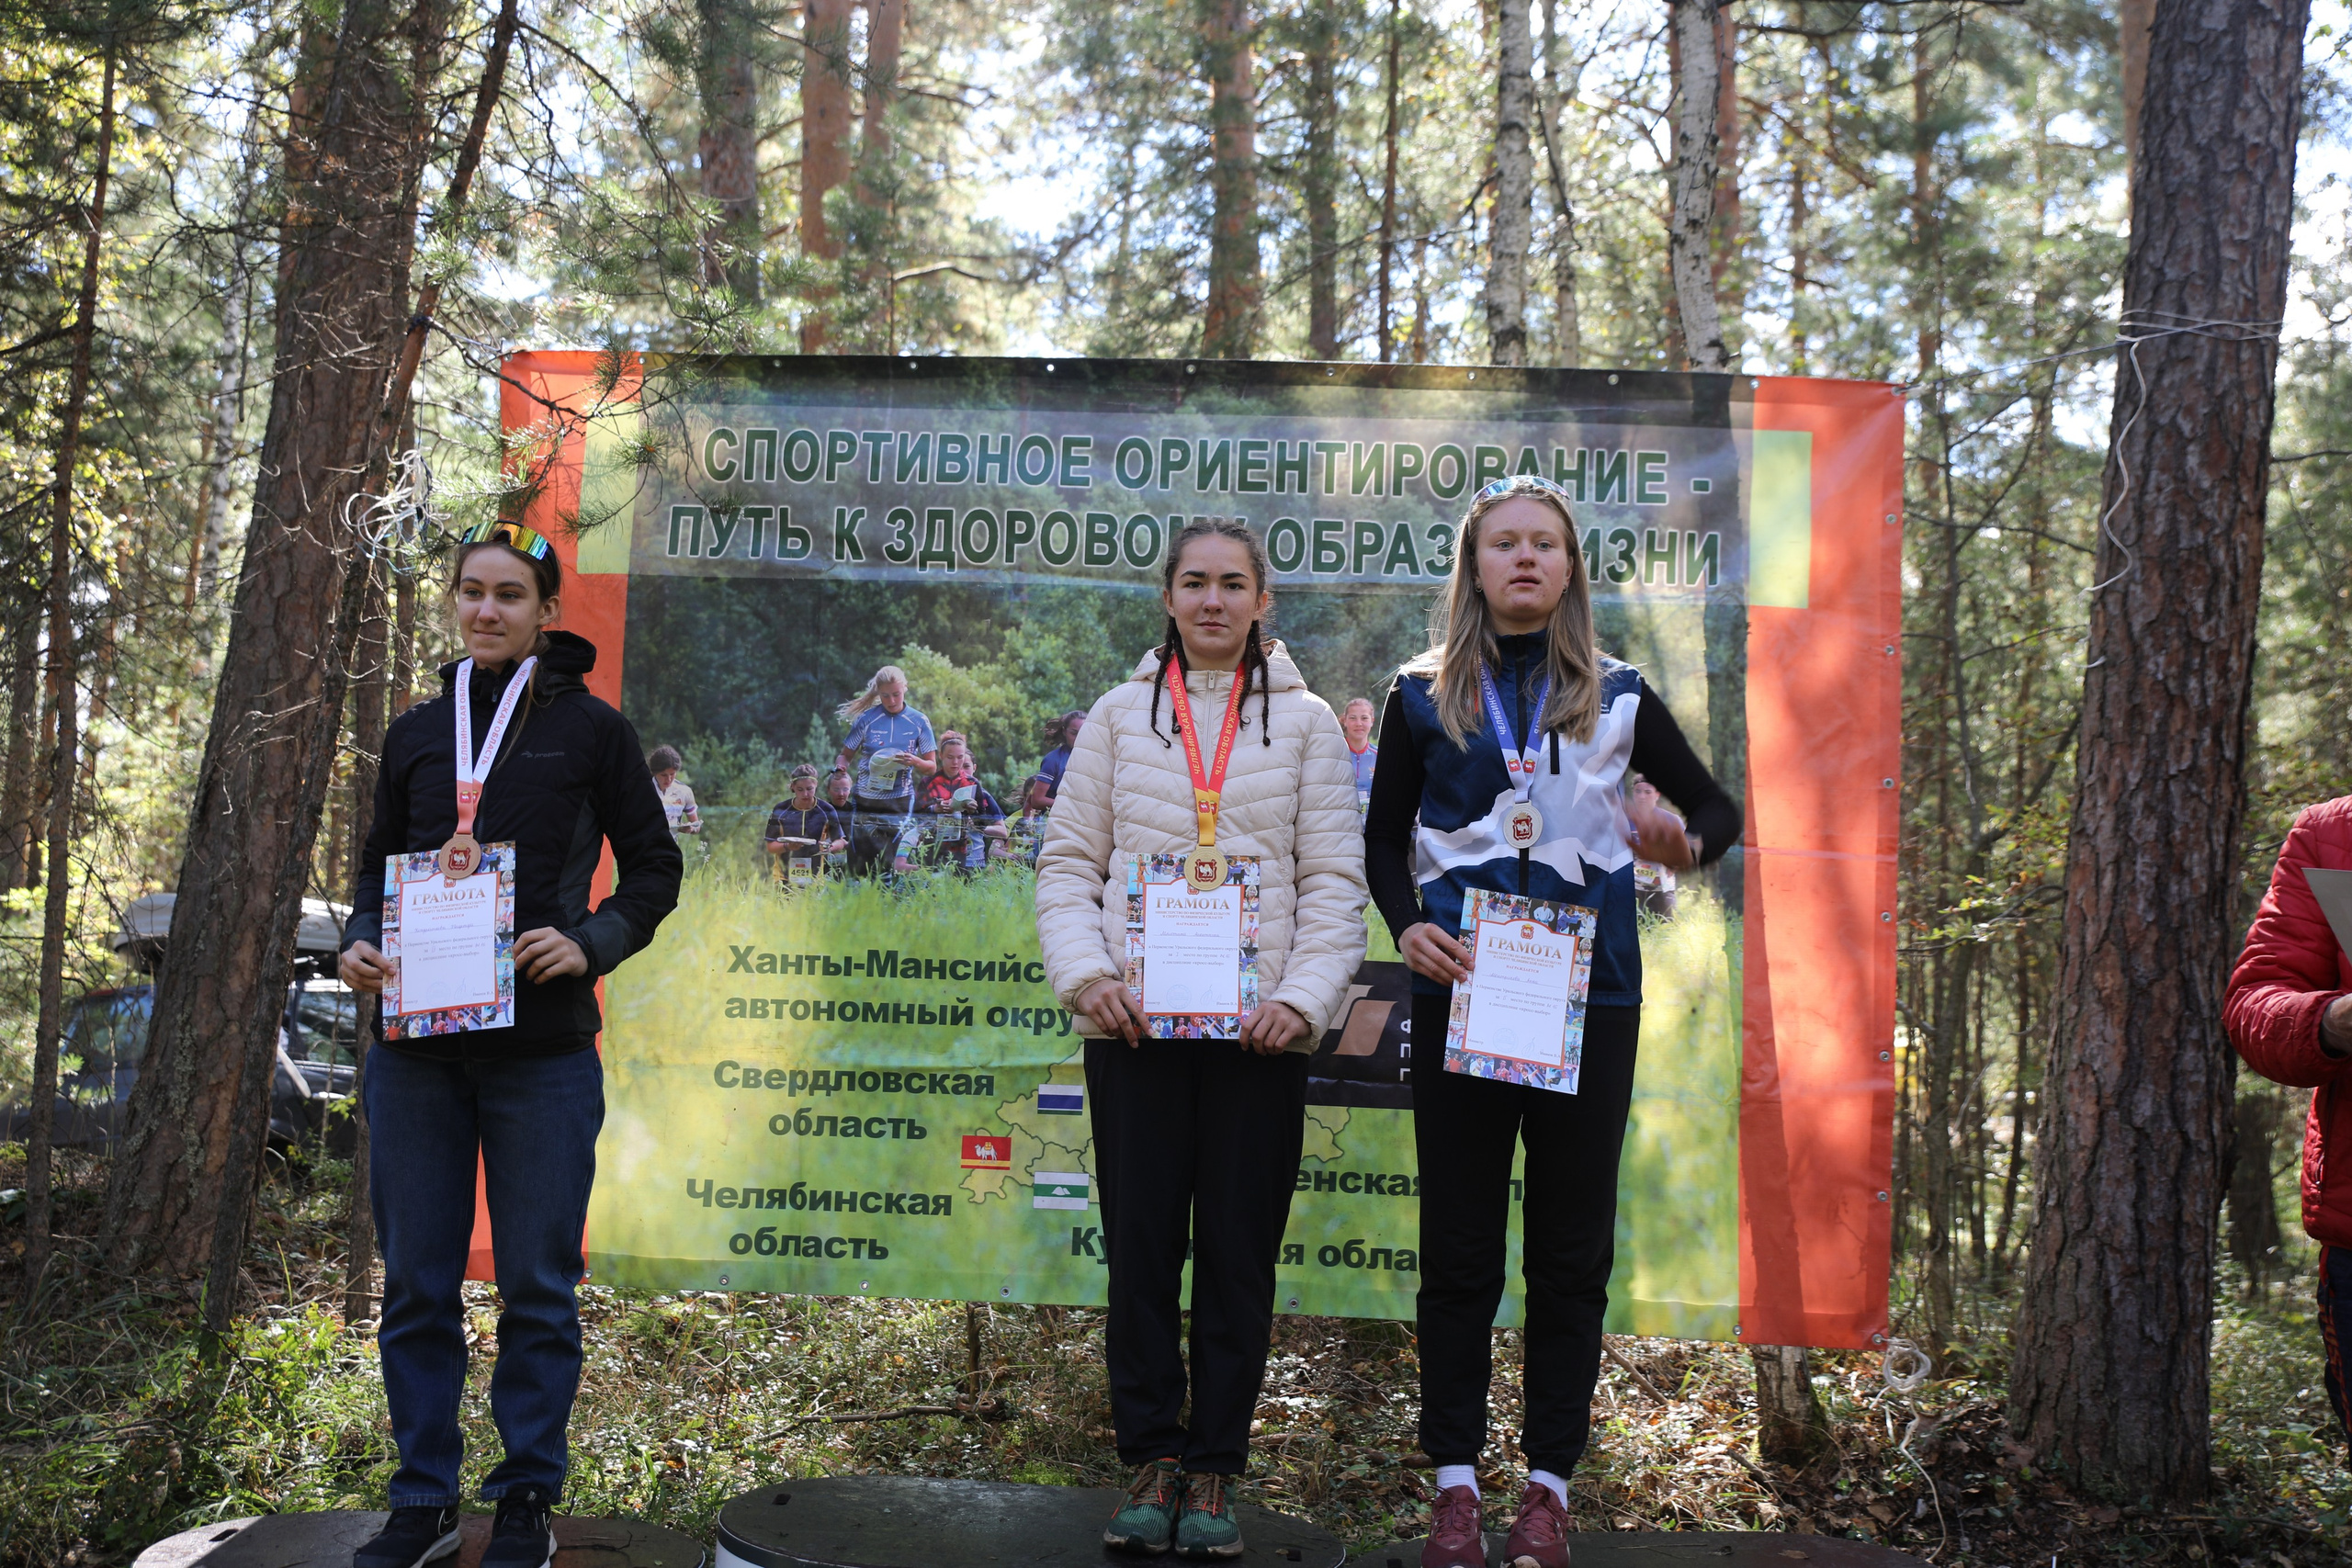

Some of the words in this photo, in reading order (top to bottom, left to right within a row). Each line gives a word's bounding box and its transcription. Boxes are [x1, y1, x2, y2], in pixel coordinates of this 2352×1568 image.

[704, 426, 1093, 488] СПОРТИВНОЕ
[1114, 434, 1668, 505] ОРИЕНТИРОВАНИЕ
[667, 504, 811, 560] ПУТЬ
[833, 506, 865, 562] К
[884, 507, 1248, 572] ЗДОРОВО
[1267, 515, 1455, 579] ОБРАЗ
[1578, 525, 1720, 589] ИЗНИ
[459, 668, 469, 704] ОБЛАСТЬ
[497, 669, 528, 725] ЧЕЛЯБИНСКАЯ
[1171, 673, 1186, 711] ОБЛАСТЬ
[1482, 679, 1507, 735] ЧЕЛЯБИНСКАЯ
[459, 705, 469, 766] ЧЕЛЯБИНСКАЯ
[481, 725, 501, 765] ОБЛАСТЬ
[1181, 712, 1201, 774] ЧЕЛЯБИНСКАЯ
[1215, 735, 1230, 775] ОБЛАСТЬ
[412, 886, 486, 906] ГРАМОТА
[1156, 897, 1230, 909] ГРАМОТА
[727, 943, 1046, 984] Ханты-Мансийс
[1487, 936, 1562, 959] ГРАМОТА
[724, 996, 974, 1027] автономный
[986, 1004, 1073, 1037] окру
[713, 1059, 995, 1098] Свердловская
[768, 1107, 928, 1140] область
[685, 1178, 953, 1216] Челябинская
[1295, 1168, 1420, 1197] енска
[729, 1225, 889, 1260] область
[1317, 1238, 1418, 1272] обла
